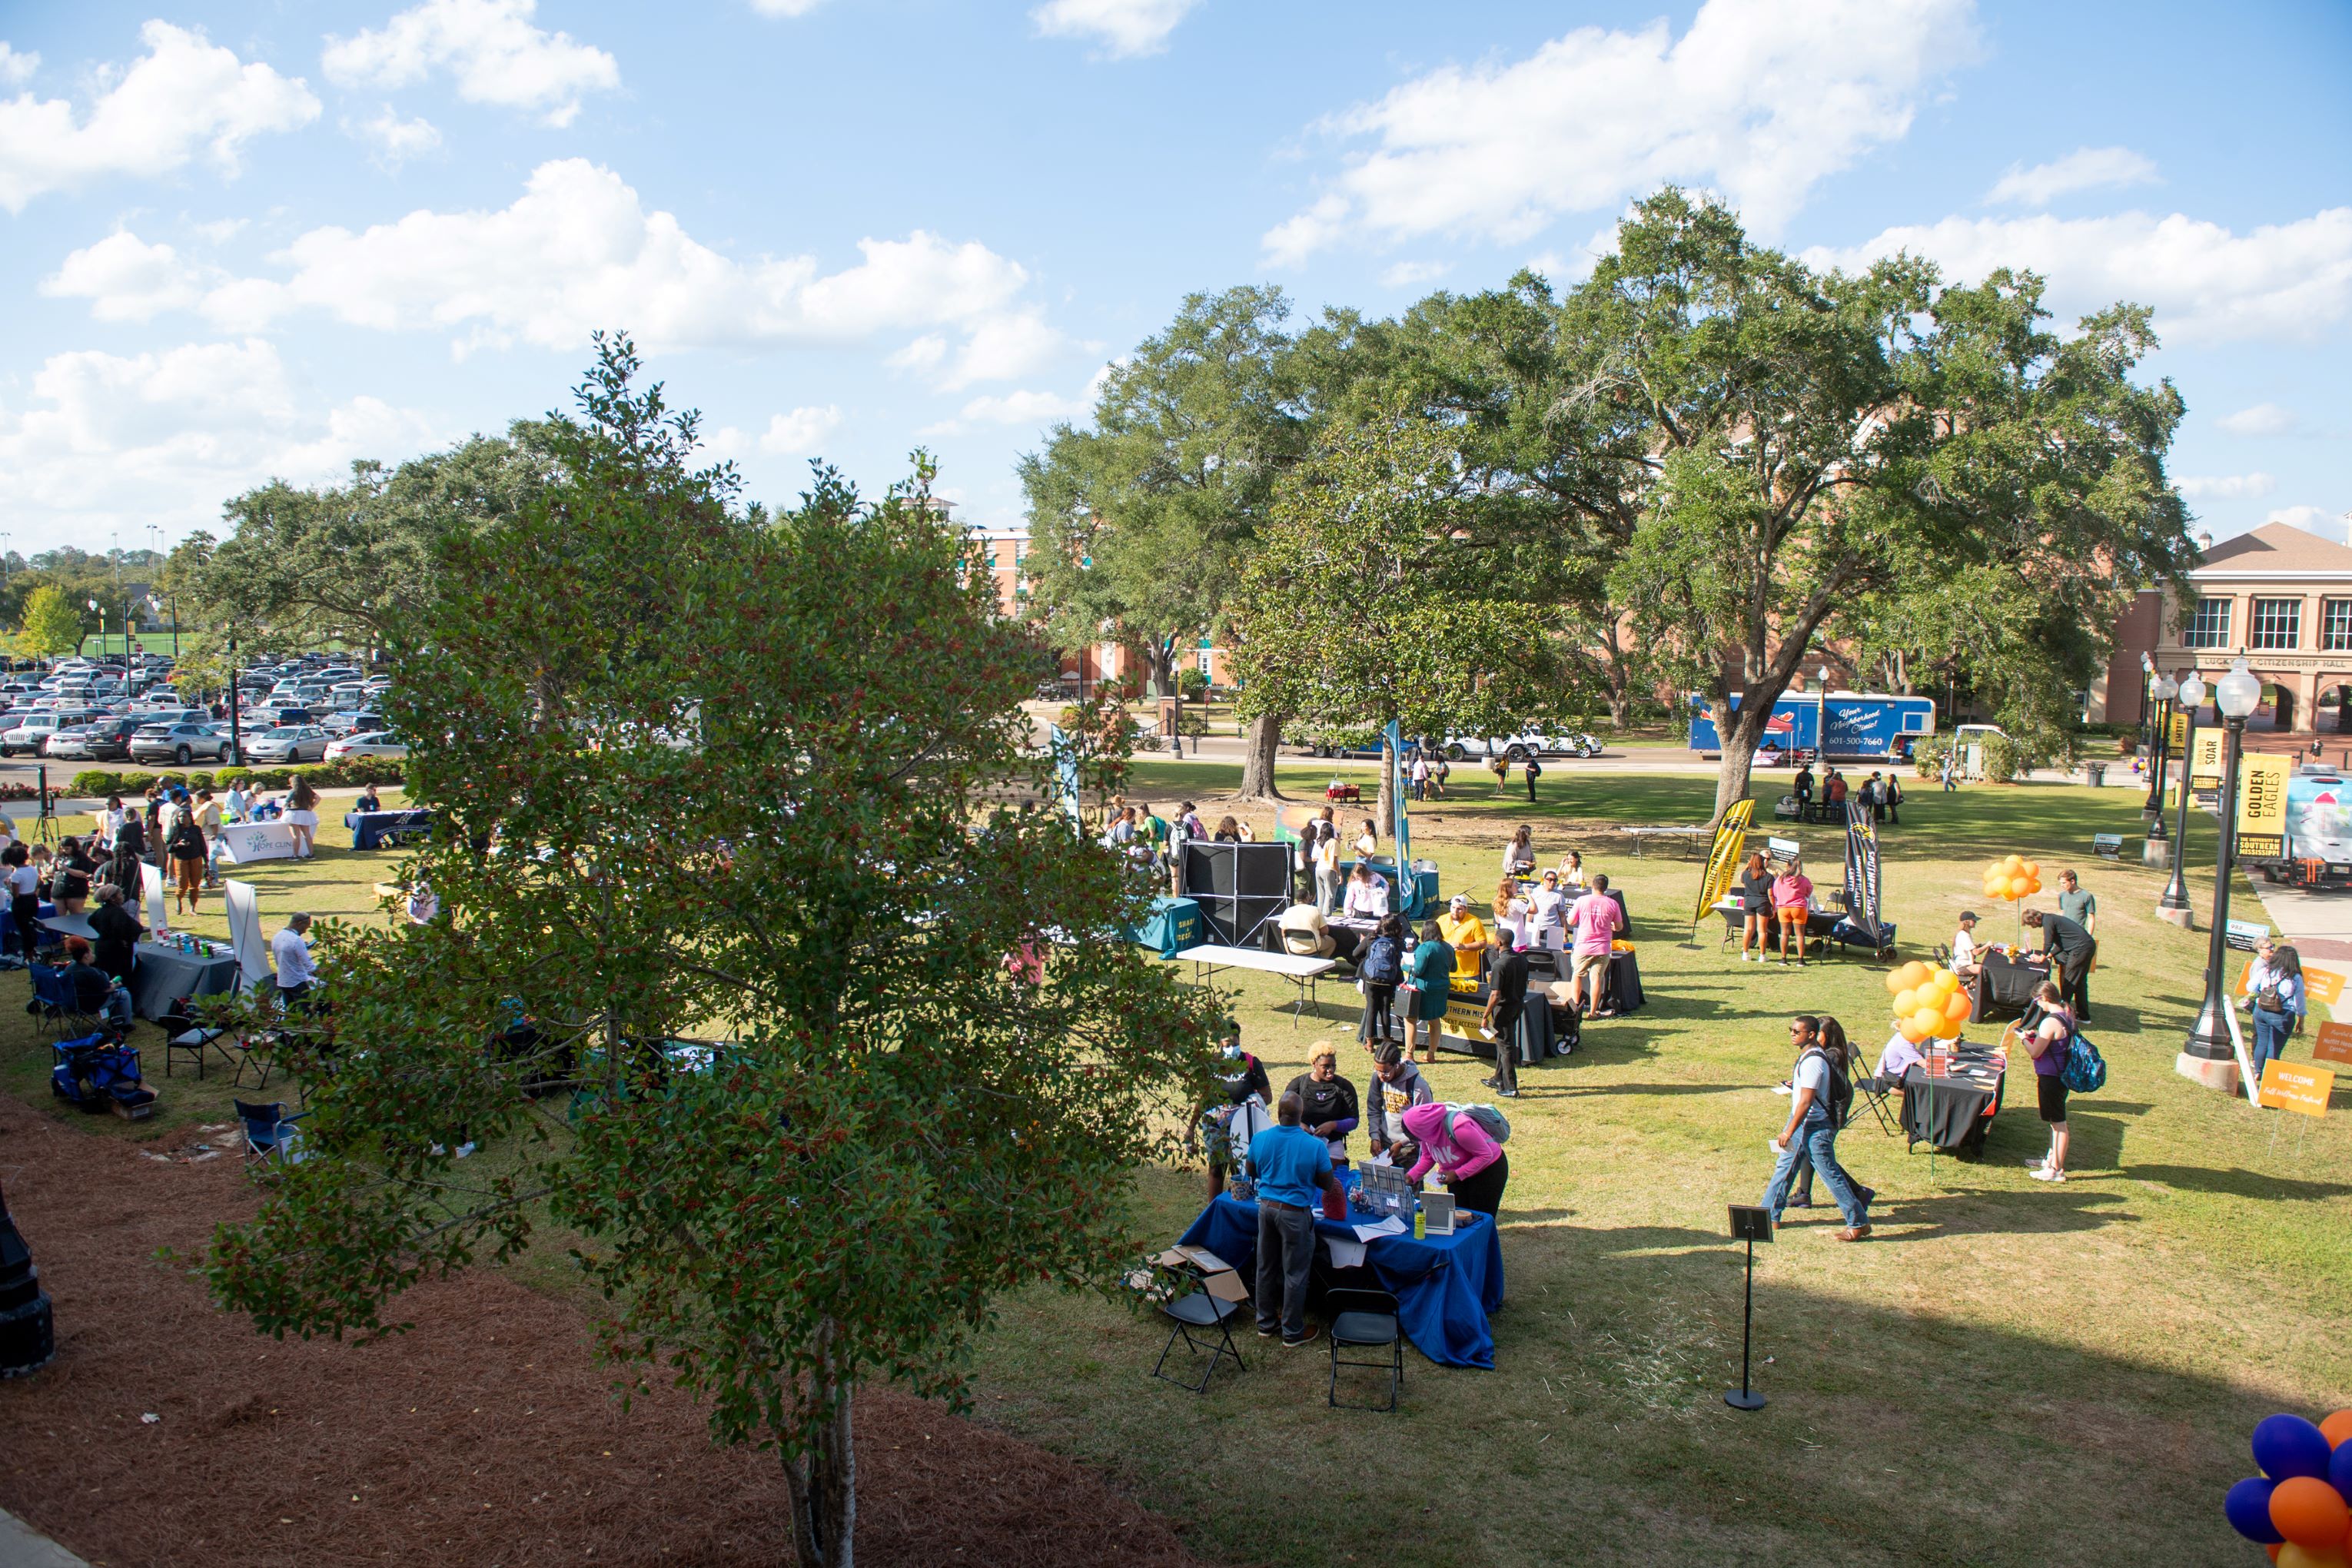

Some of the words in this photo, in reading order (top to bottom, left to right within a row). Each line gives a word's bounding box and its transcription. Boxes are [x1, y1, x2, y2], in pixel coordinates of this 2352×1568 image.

[2257, 659, 2318, 667] CITIZENSHIP
[2323, 659, 2347, 668] HALL
[1830, 709, 1881, 731] Neighborhood
[1839, 707, 1862, 719] Your
[1851, 719, 1878, 734] Clinic!
[1829, 737, 1882, 746] 601-500-7660
[2197, 749, 2205, 766] BORN
[2205, 741, 2217, 766] SOAR
[2247, 770, 2264, 818] GOLDEN
[2262, 772, 2281, 817] EAGLES
[2239, 842, 2281, 850] SOUTHERN
[1704, 860, 1720, 902] SOUTHERN
[1719, 870, 1729, 895] MOFFITT
[1866, 851, 1876, 895] SOUTHERN
[1853, 882, 1862, 907] HEALTH
[1866, 895, 1875, 916] MISS
[1447, 1006, 1471, 1016] THERN
[1472, 1010, 1484, 1018] MIS
[2278, 1071, 2315, 1087] WELCOME
[2264, 1087, 2277, 1095] Fall
[2299, 1094, 2324, 1105] Festival
